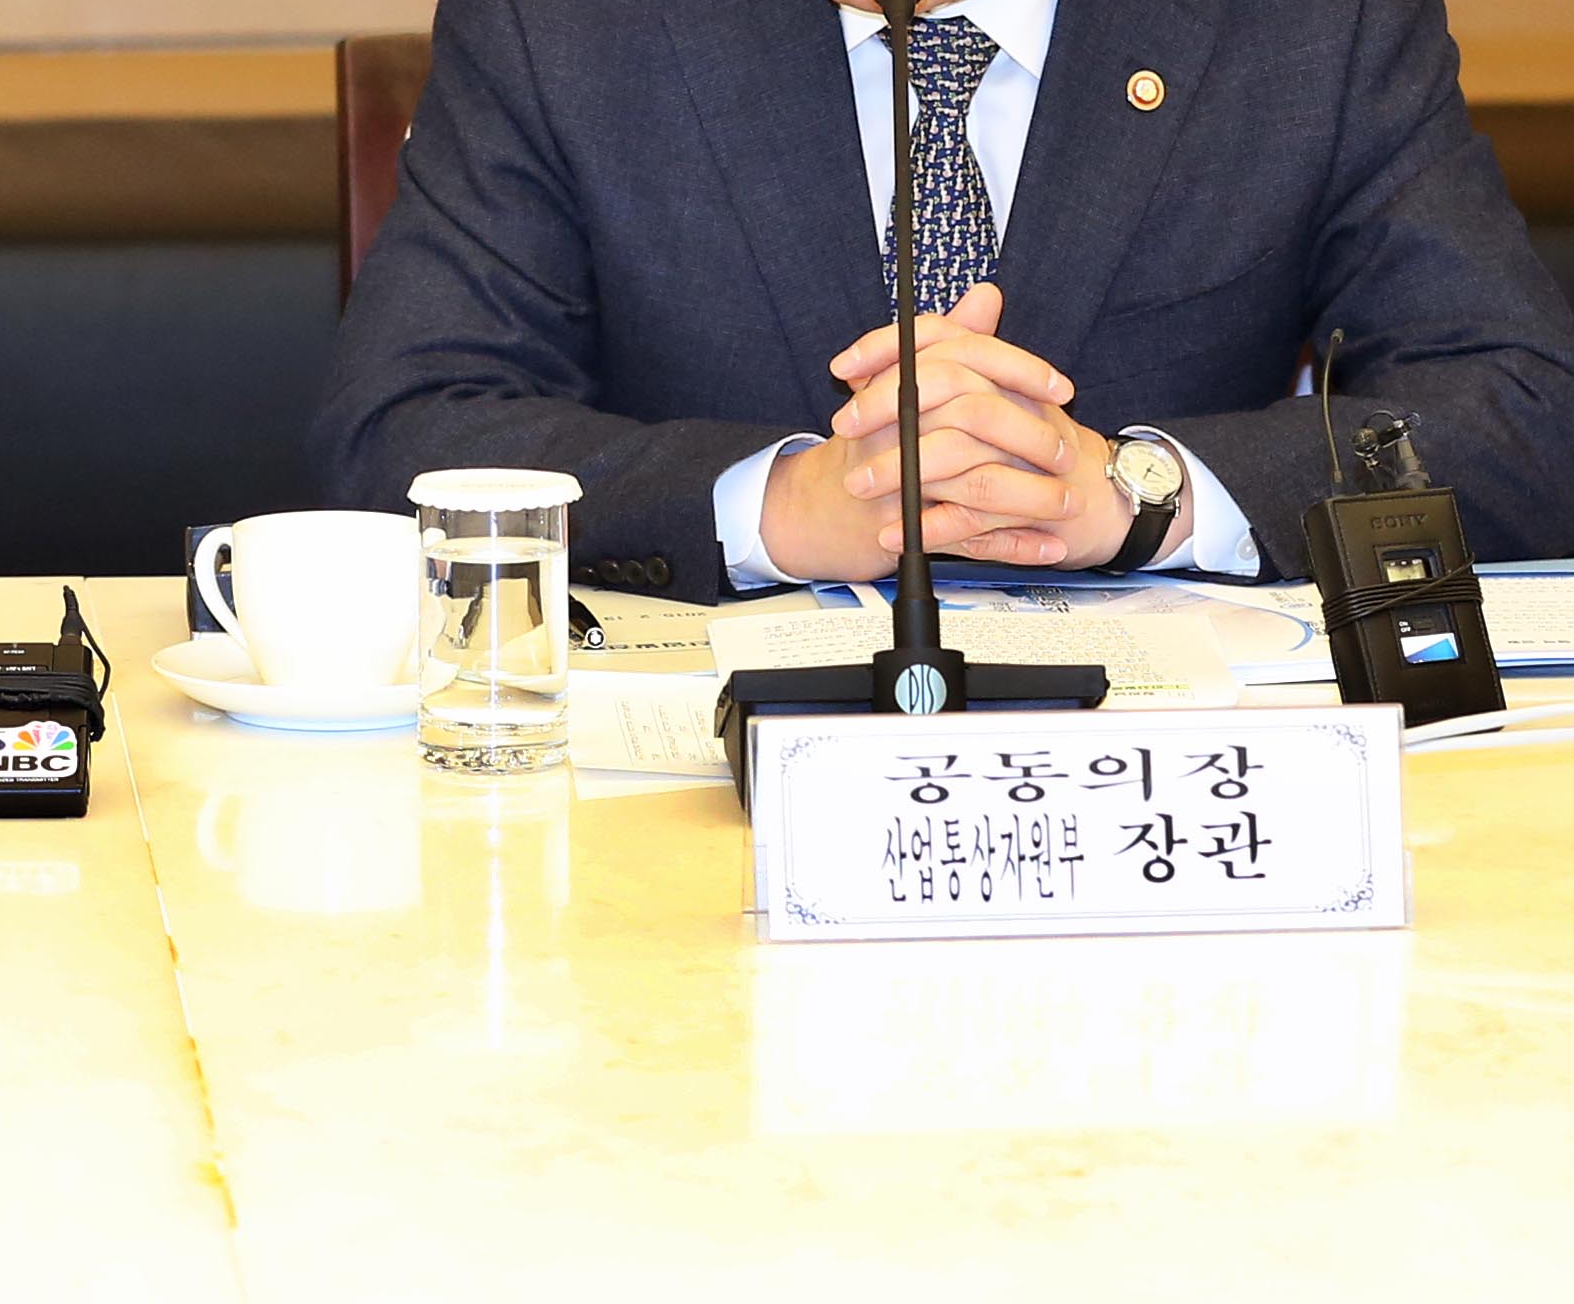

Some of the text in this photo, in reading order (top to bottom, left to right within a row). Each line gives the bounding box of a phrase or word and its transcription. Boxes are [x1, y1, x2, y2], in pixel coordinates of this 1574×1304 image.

[884, 745, 1264, 804] 공동의장
[881, 810, 1273, 903] 산업통상자원부 장관
